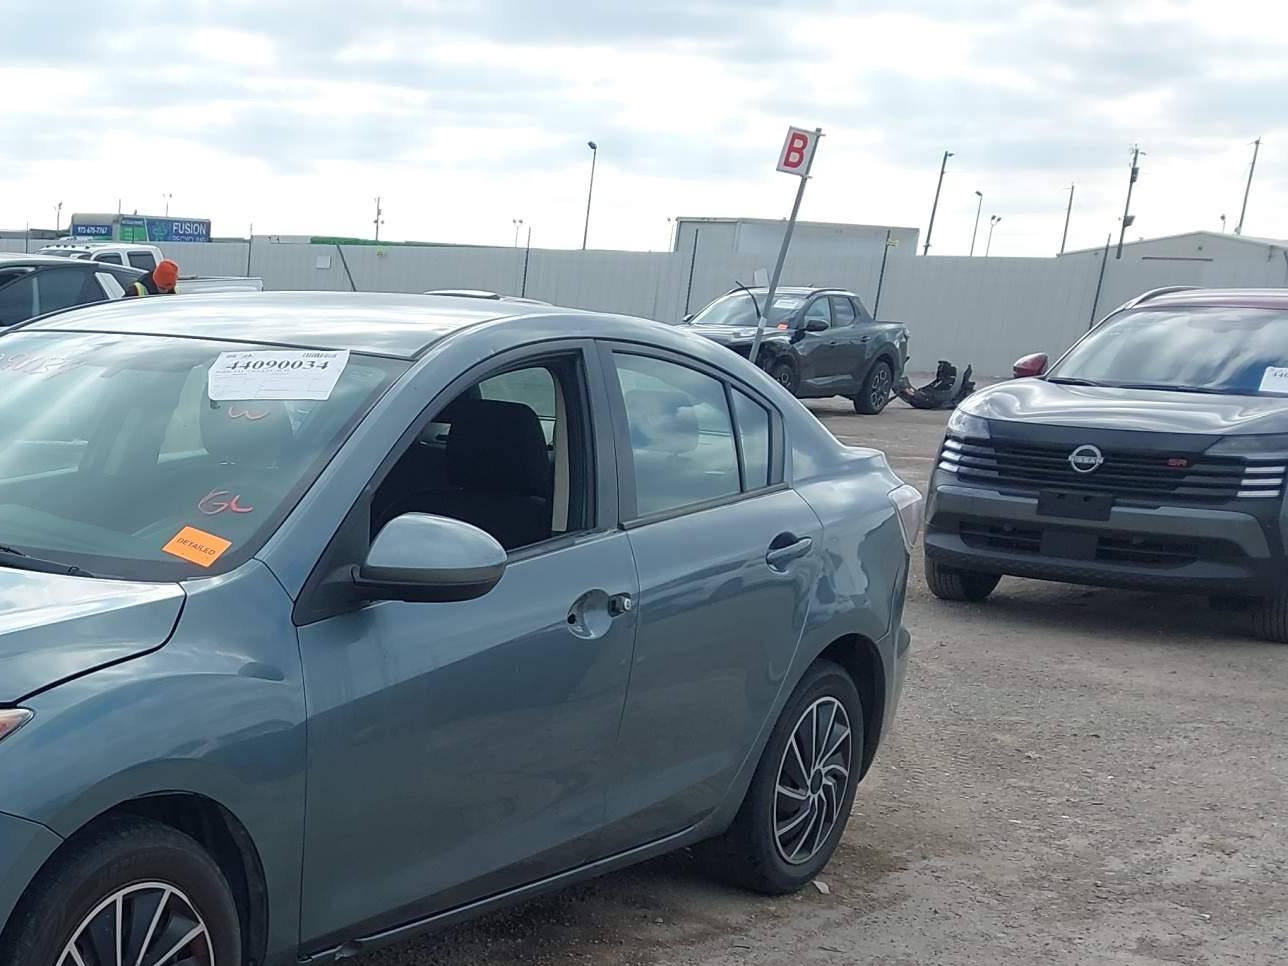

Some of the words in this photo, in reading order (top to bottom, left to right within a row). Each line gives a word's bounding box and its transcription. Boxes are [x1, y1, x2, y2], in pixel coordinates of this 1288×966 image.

[783, 132, 809, 169] B
[172, 222, 207, 235] FUSION
[225, 360, 329, 370] 44090034
[198, 488, 255, 516] GL
[176, 537, 217, 556] DETAILED
